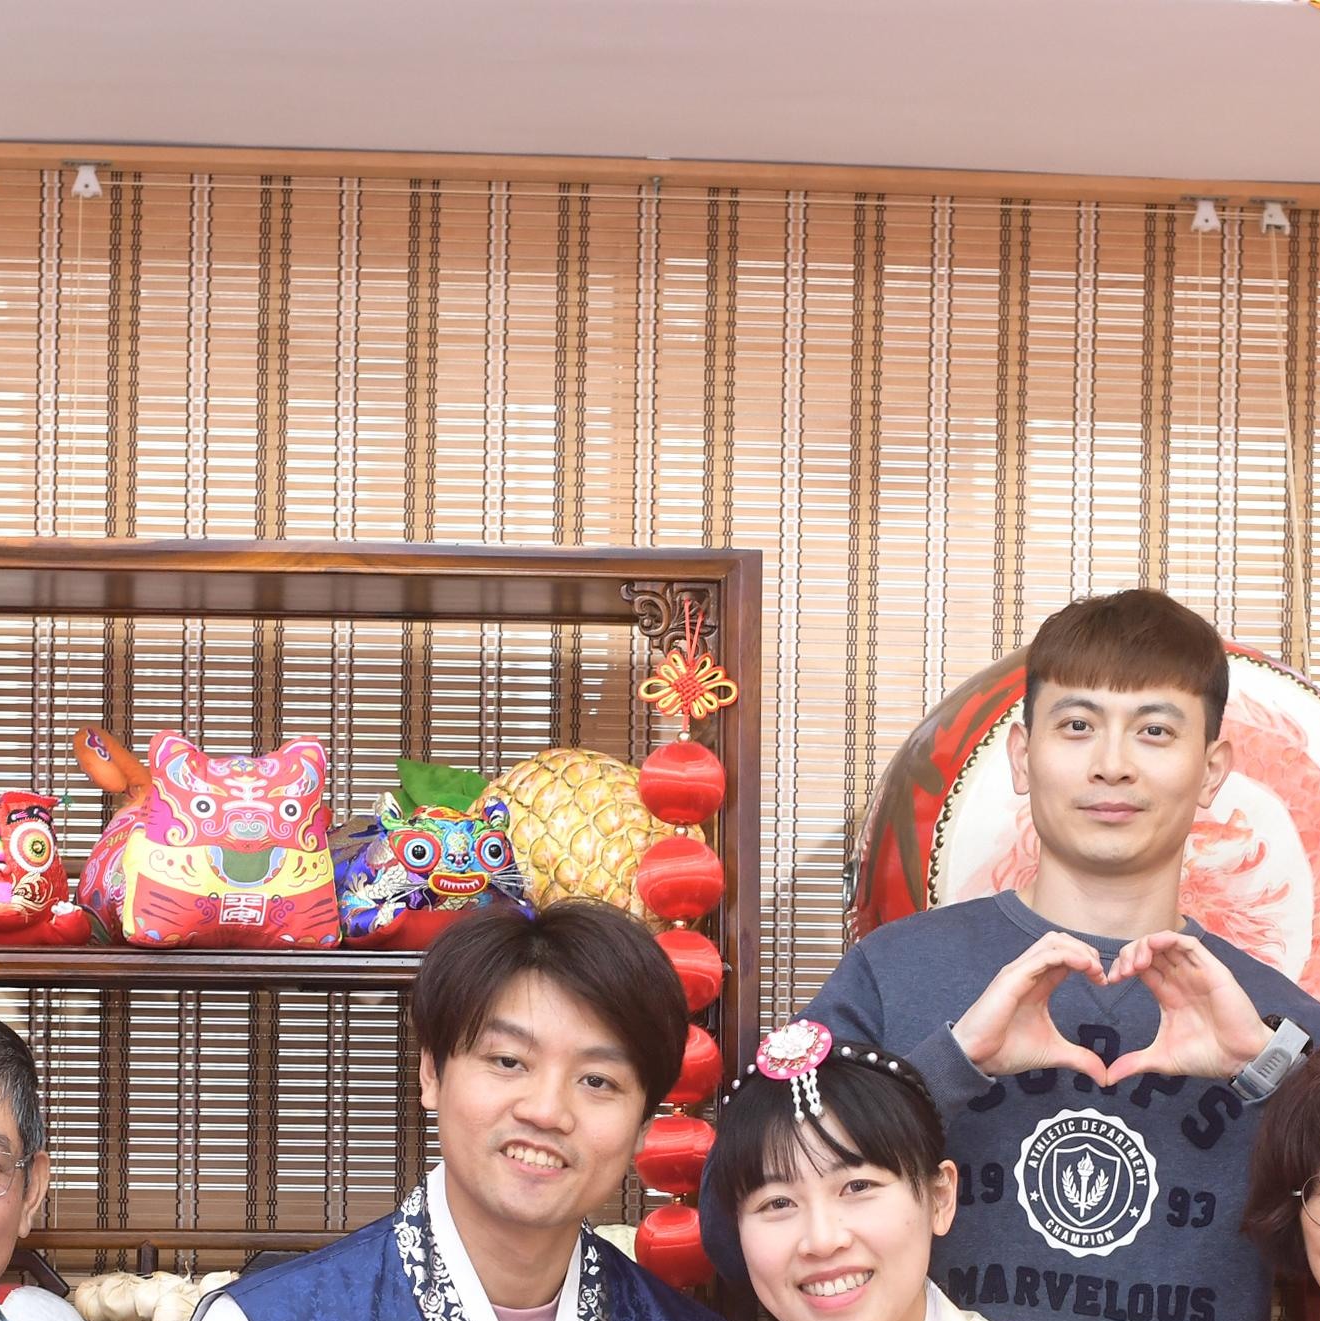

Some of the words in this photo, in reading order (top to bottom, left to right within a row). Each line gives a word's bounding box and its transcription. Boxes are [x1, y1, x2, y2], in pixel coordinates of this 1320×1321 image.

[1027, 1119, 1076, 1169] ATHLETIC
[1081, 1119, 1148, 1188] DEPARTMENT
[958, 1162, 1004, 1205] 19
[1166, 1186, 1217, 1228] 93
[1044, 1220, 1115, 1246] CHAMPION
